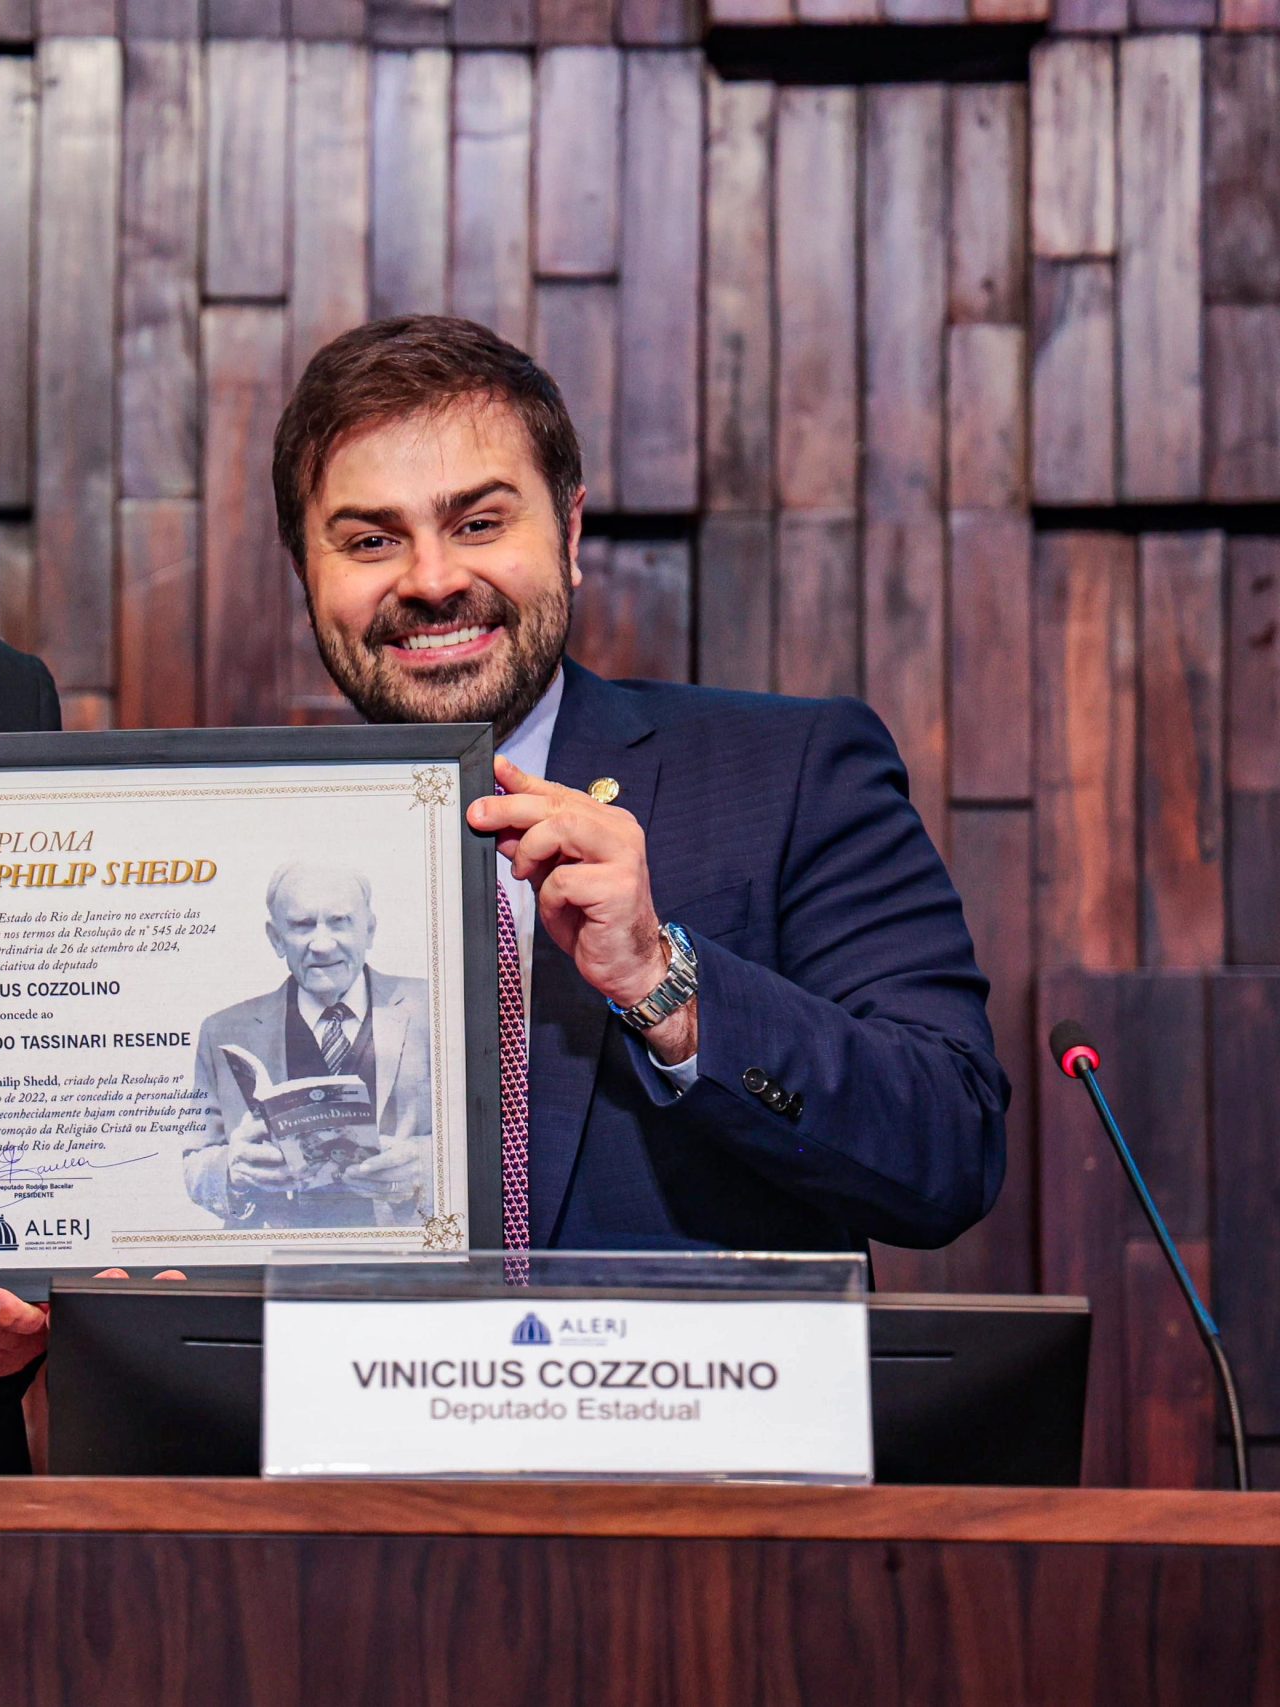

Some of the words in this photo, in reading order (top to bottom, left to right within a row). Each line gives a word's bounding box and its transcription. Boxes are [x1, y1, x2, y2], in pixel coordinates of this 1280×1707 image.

[101, 858, 218, 887] SHEDD
[35, 911, 47, 922] do
[50, 911, 68, 922] Rio
[71, 910, 82, 921] de
[83, 910, 120, 923] Janeiro
[139, 908, 180, 920] exercício
[184, 908, 200, 919] das
[23, 928, 55, 938] termos
[58, 927, 70, 938] da
[74, 925, 122, 941] Resolução
[124, 925, 136, 936] de
[152, 924, 171, 935] 545
[175, 924, 186, 935] de
[189, 923, 216, 935] 2024
[46, 943, 58, 954] de
[60, 943, 74, 954] 26
[76, 943, 88, 954] de
[90, 942, 134, 953] setembro
[136, 942, 148, 953] de
[150, 941, 180, 954] 2024,
[38, 959, 49, 970] do
[52, 958, 98, 973] deputado
[27, 981, 120, 997] COZZOLINO
[21, 1034, 106, 1050] TASSINARI
[113, 1032, 191, 1048] RESENDE
[23, 1075, 61, 1088] Shedd,
[64, 1074, 95, 1086] criado
[97, 1074, 117, 1088] pela
[121, 1073, 169, 1088] Resolução
[4, 1092, 15, 1103] de
[18, 1091, 48, 1104] 2022,
[77, 1090, 123, 1102] concedido
[134, 1088, 208, 1104] personalidades
[84, 1106, 115, 1121] hajam
[119, 1105, 176, 1117] contribuído
[178, 1108, 202, 1119] para
[40, 1124, 52, 1135] da
[56, 1123, 98, 1138] Religião
[101, 1122, 132, 1134] Cristã
[150, 1121, 207, 1136] Evangélica
[18, 1140, 28, 1151] do
[32, 1140, 50, 1151] Rio
[53, 1139, 64, 1150] de
[66, 1139, 106, 1152] Janeiro.
[25, 1218, 91, 1240] ALERJ
[560, 1319, 626, 1338] ALERJ
[353, 1361, 525, 1389] VINICIUS
[539, 1361, 778, 1391] COZZOLINO
[431, 1398, 567, 1424] Deputado
[578, 1398, 700, 1421] Estadual
